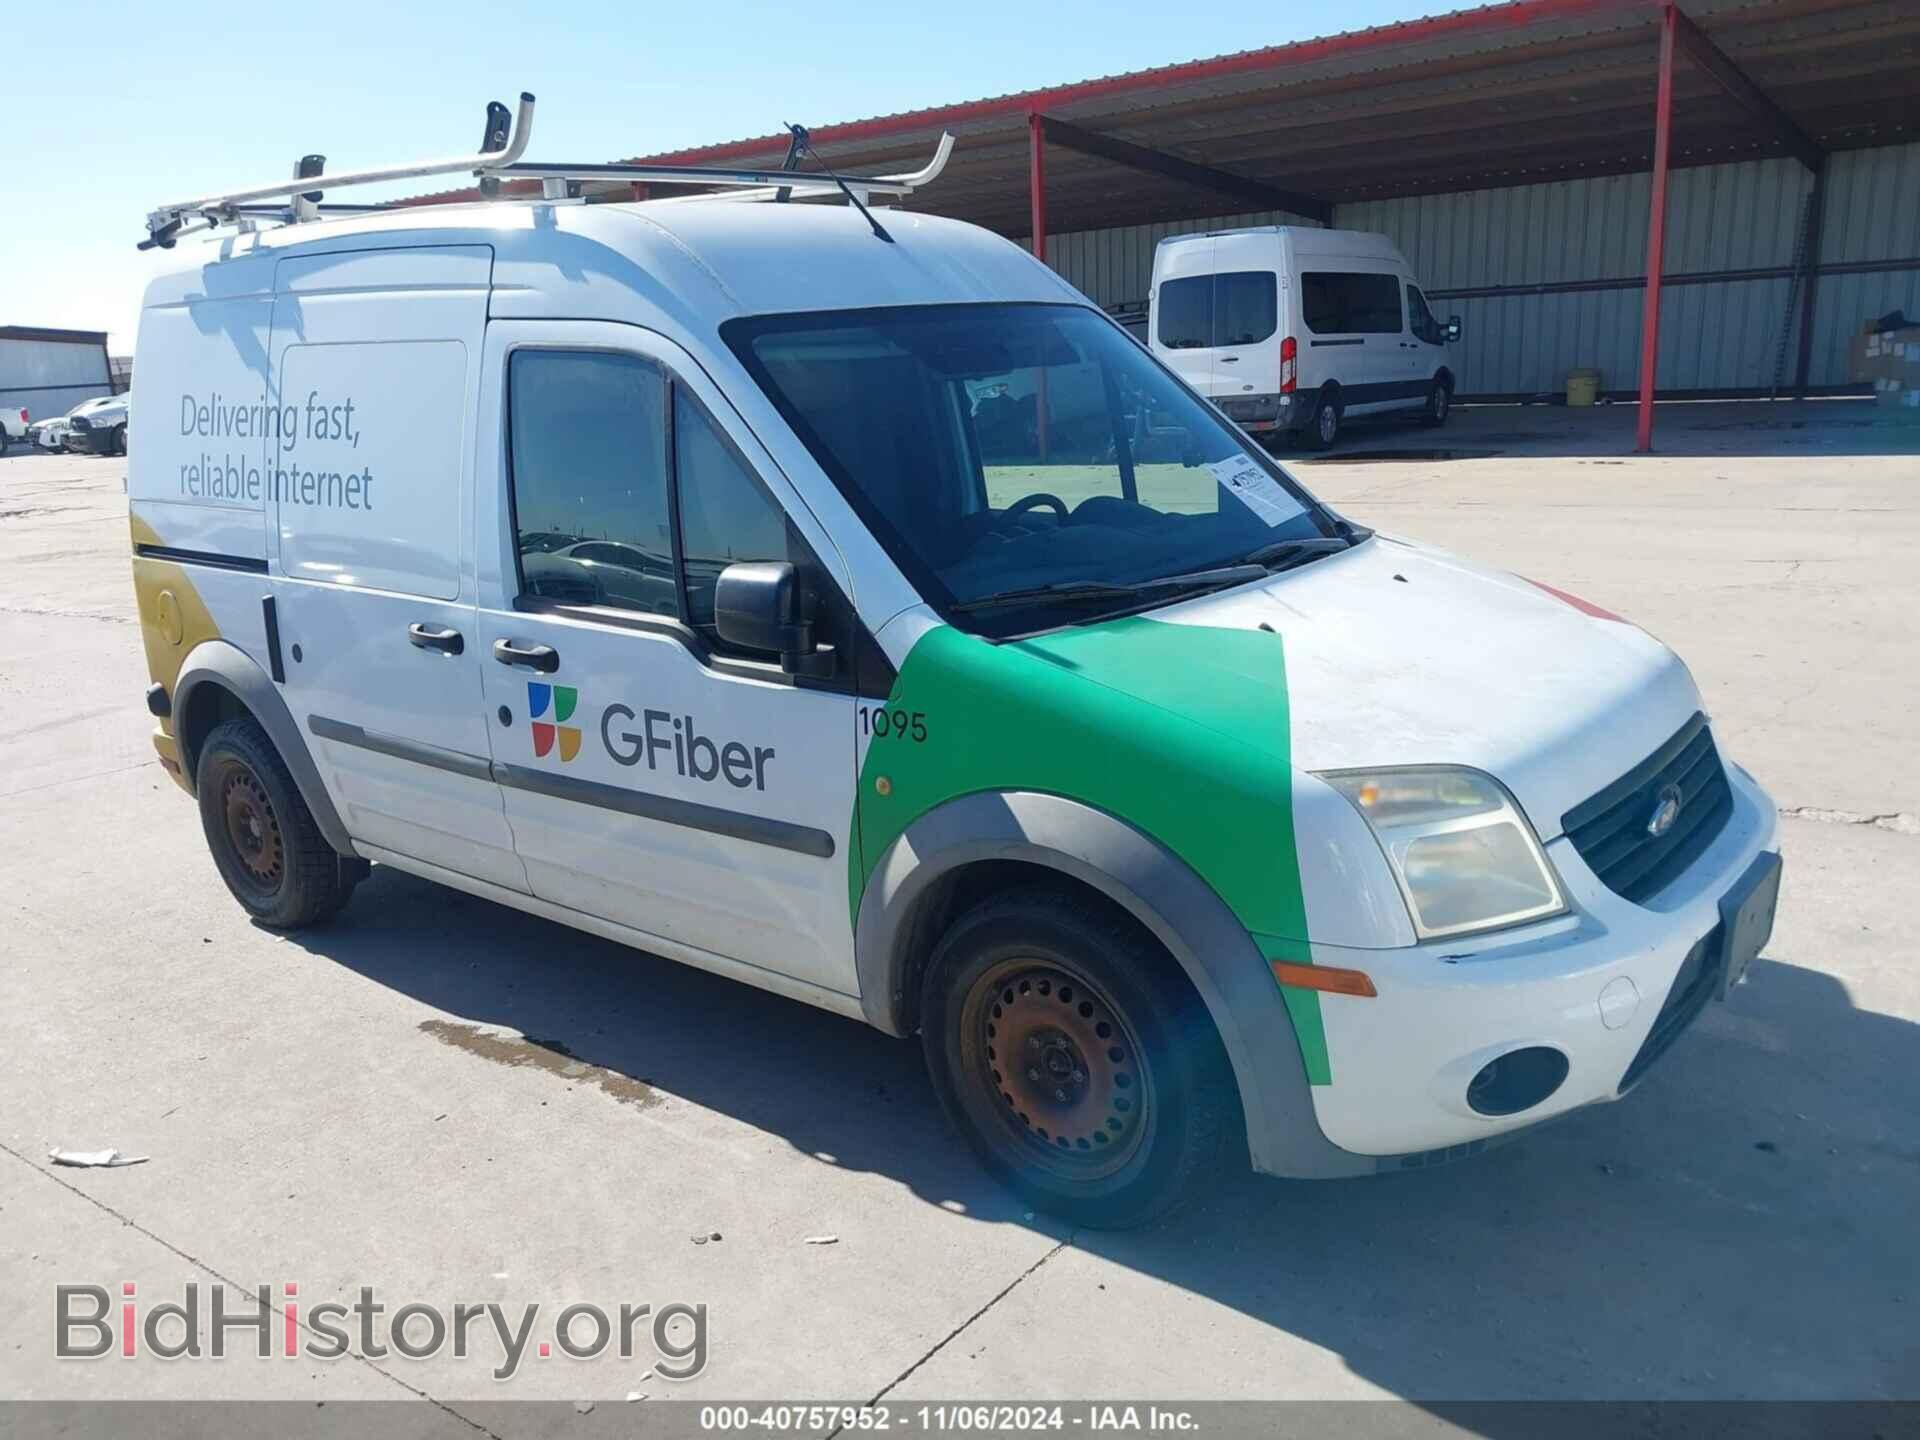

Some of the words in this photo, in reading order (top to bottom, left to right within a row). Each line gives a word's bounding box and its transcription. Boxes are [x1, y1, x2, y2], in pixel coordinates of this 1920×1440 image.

[181, 392, 299, 451] Delivering
[306, 391, 360, 448] fast,
[181, 453, 260, 500] reliable
[267, 458, 373, 511] internet
[600, 703, 776, 792] GFiber
[858, 706, 928, 743] 1095
